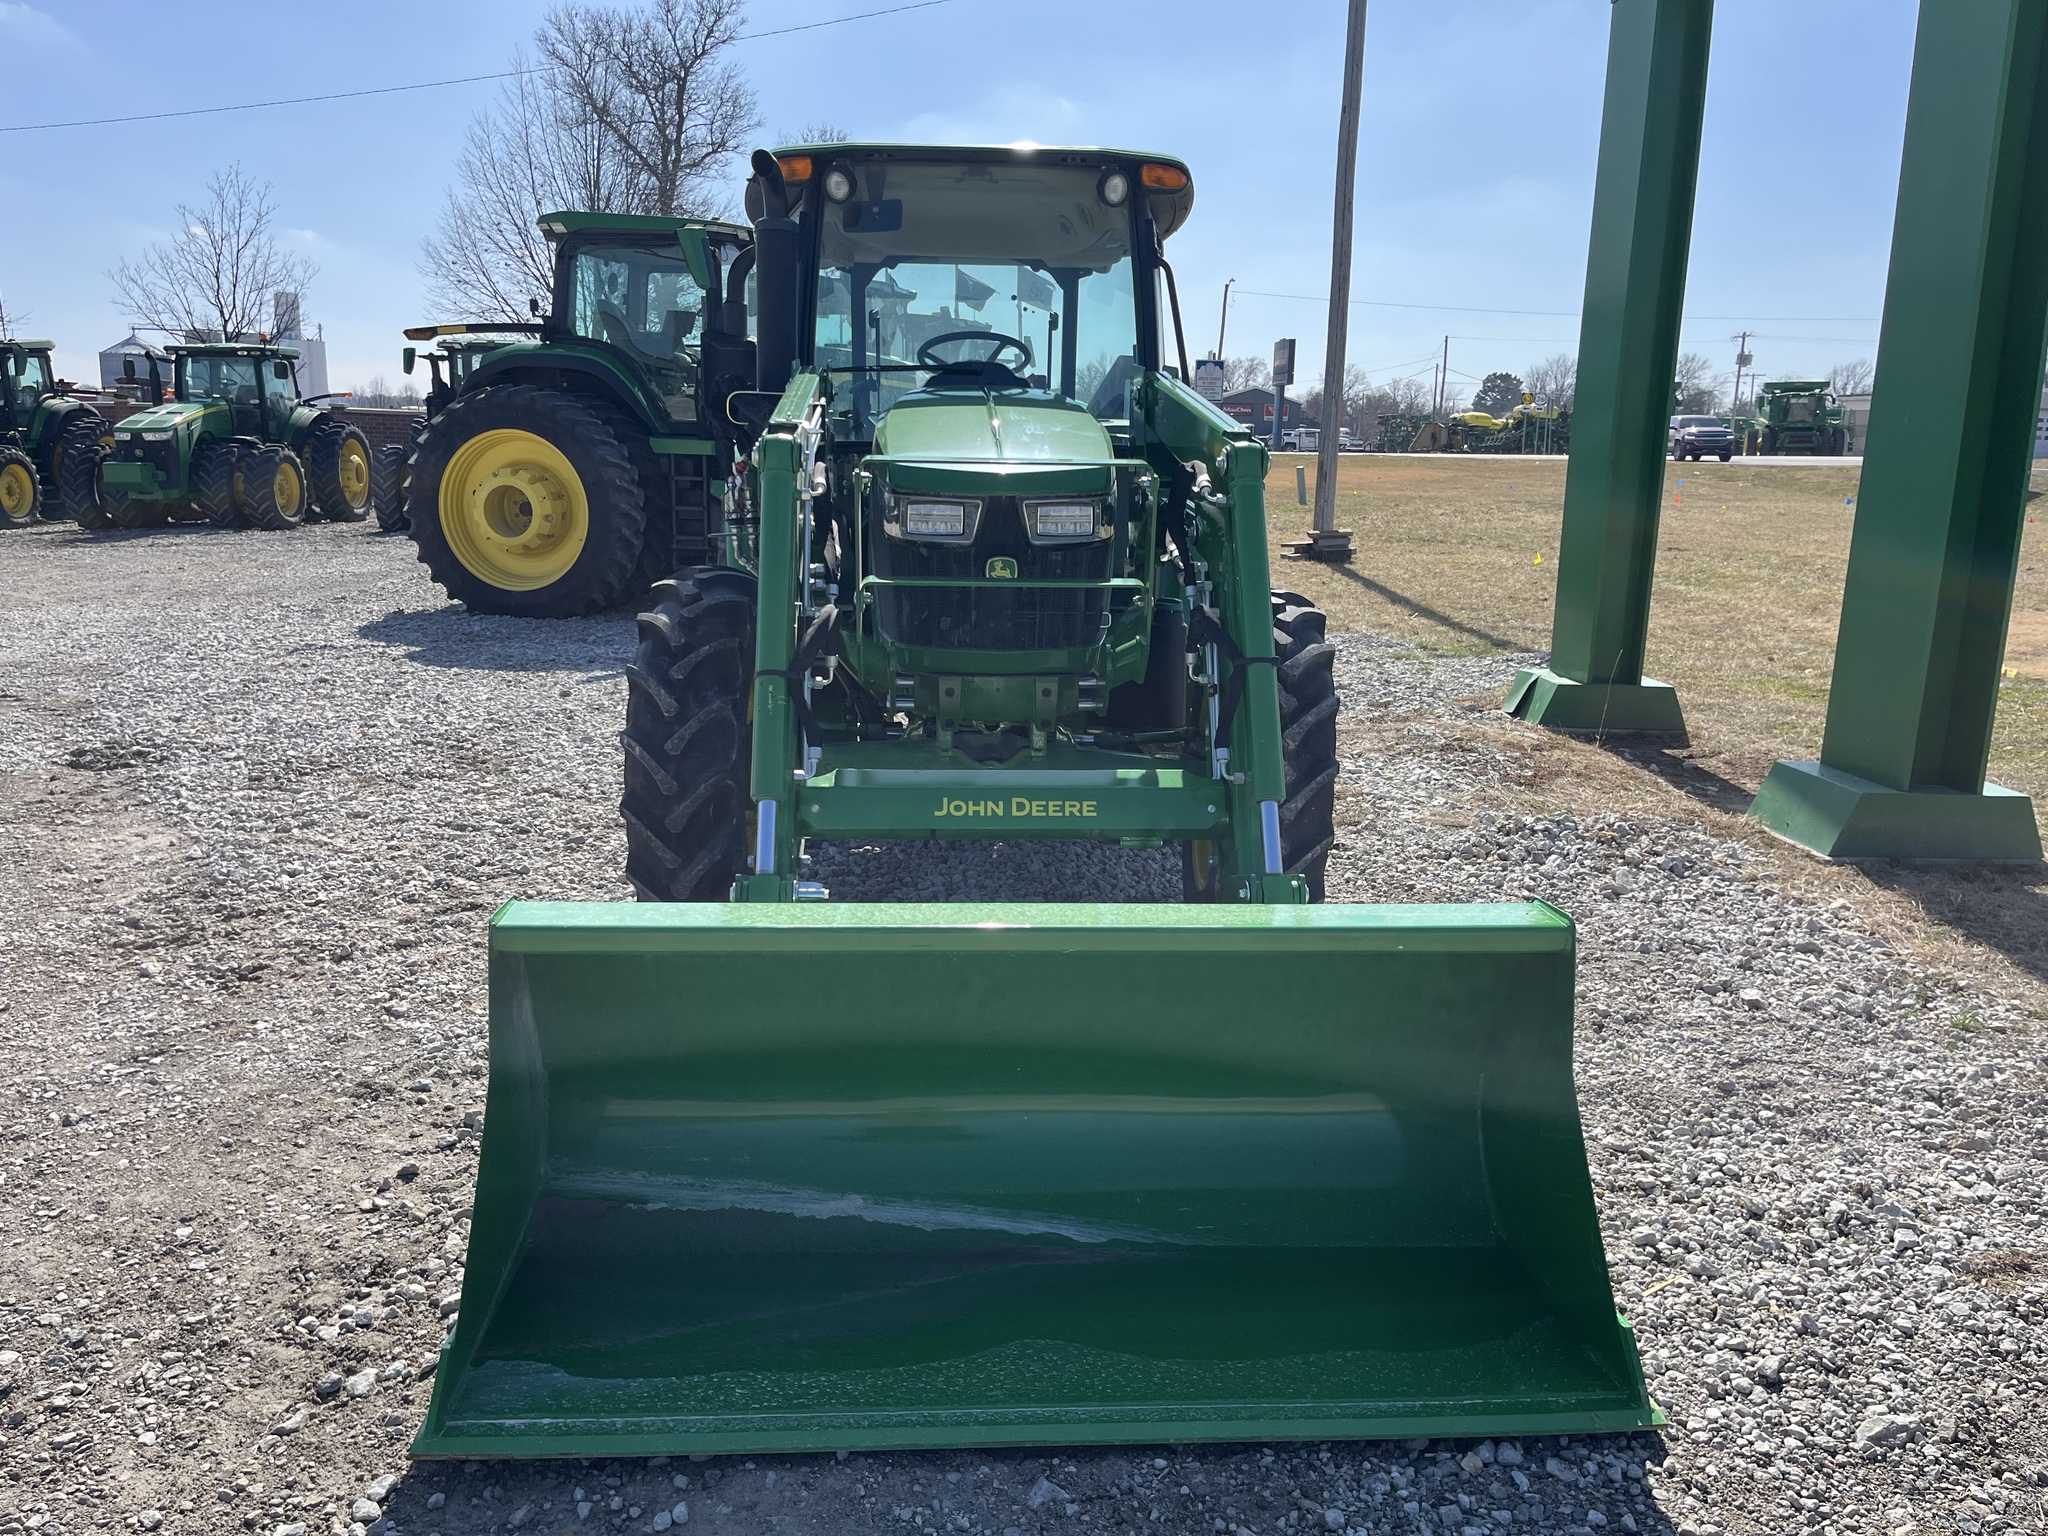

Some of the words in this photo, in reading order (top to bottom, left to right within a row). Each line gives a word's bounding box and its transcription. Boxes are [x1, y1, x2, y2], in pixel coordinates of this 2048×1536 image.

[1536, 395, 1545, 403] 36
[934, 797, 1004, 817] JOHN
[1011, 797, 1098, 817] DEERE
